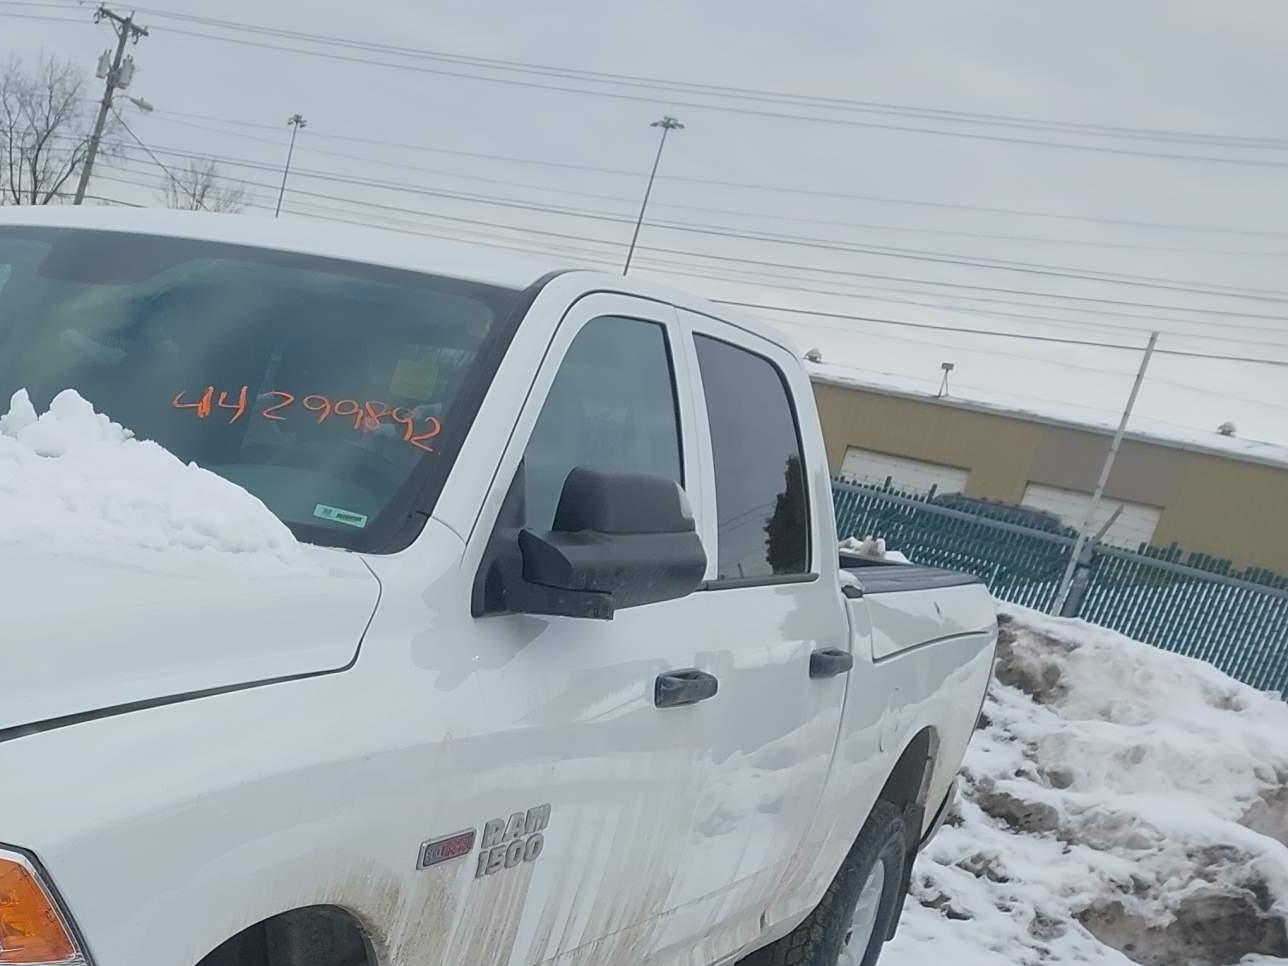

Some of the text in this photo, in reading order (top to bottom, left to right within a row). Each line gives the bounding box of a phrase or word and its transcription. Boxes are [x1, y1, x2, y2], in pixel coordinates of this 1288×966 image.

[171, 385, 442, 452] 44299892
[481, 803, 552, 849] RAM
[475, 832, 545, 879] 1500
